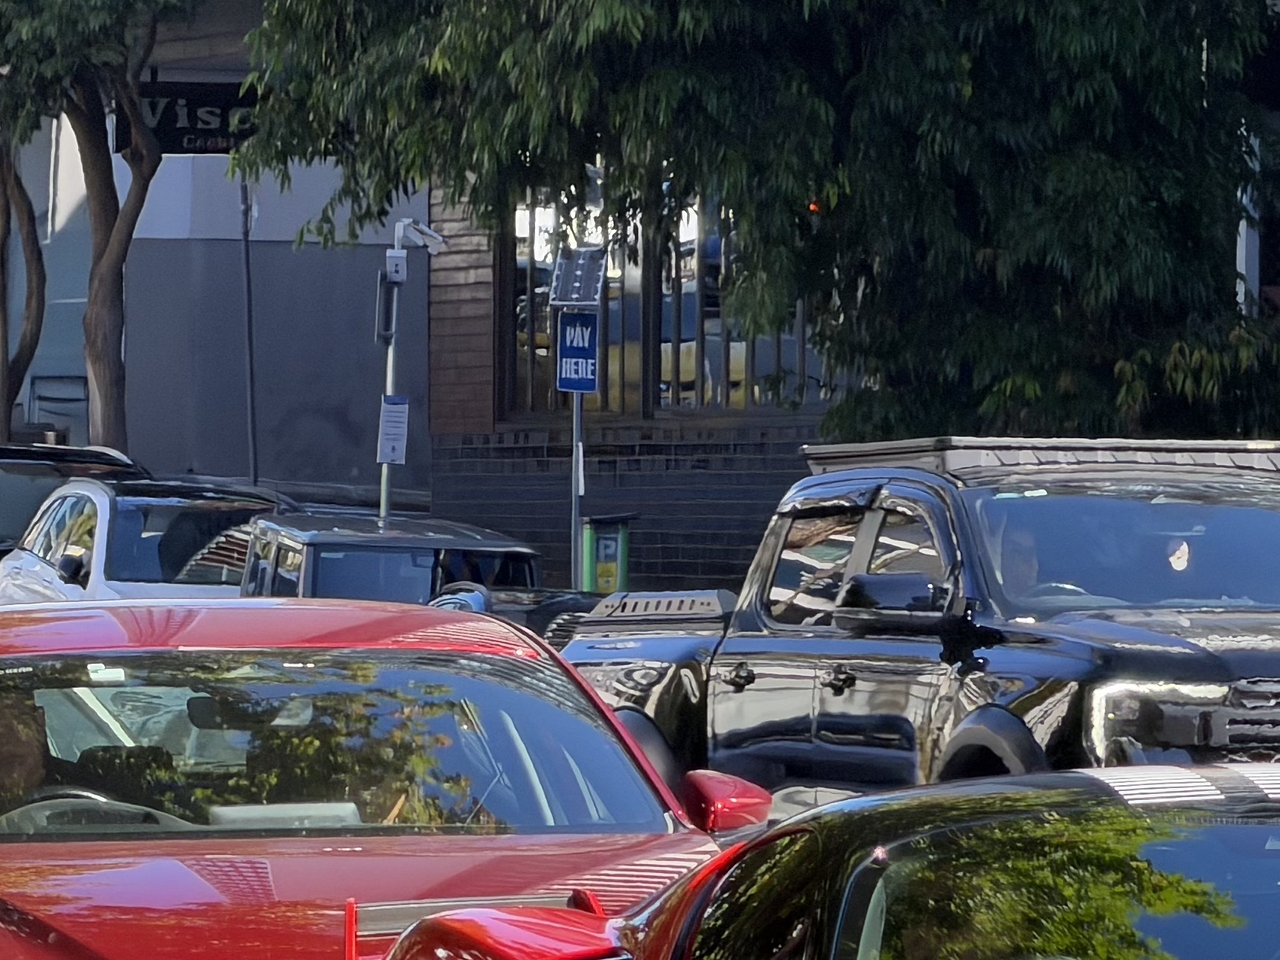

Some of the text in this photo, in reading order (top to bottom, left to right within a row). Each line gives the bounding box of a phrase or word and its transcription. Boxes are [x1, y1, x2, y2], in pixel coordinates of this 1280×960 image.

[566, 321, 591, 348] PAY
[561, 358, 595, 379] HERE
[598, 539, 616, 561] P
